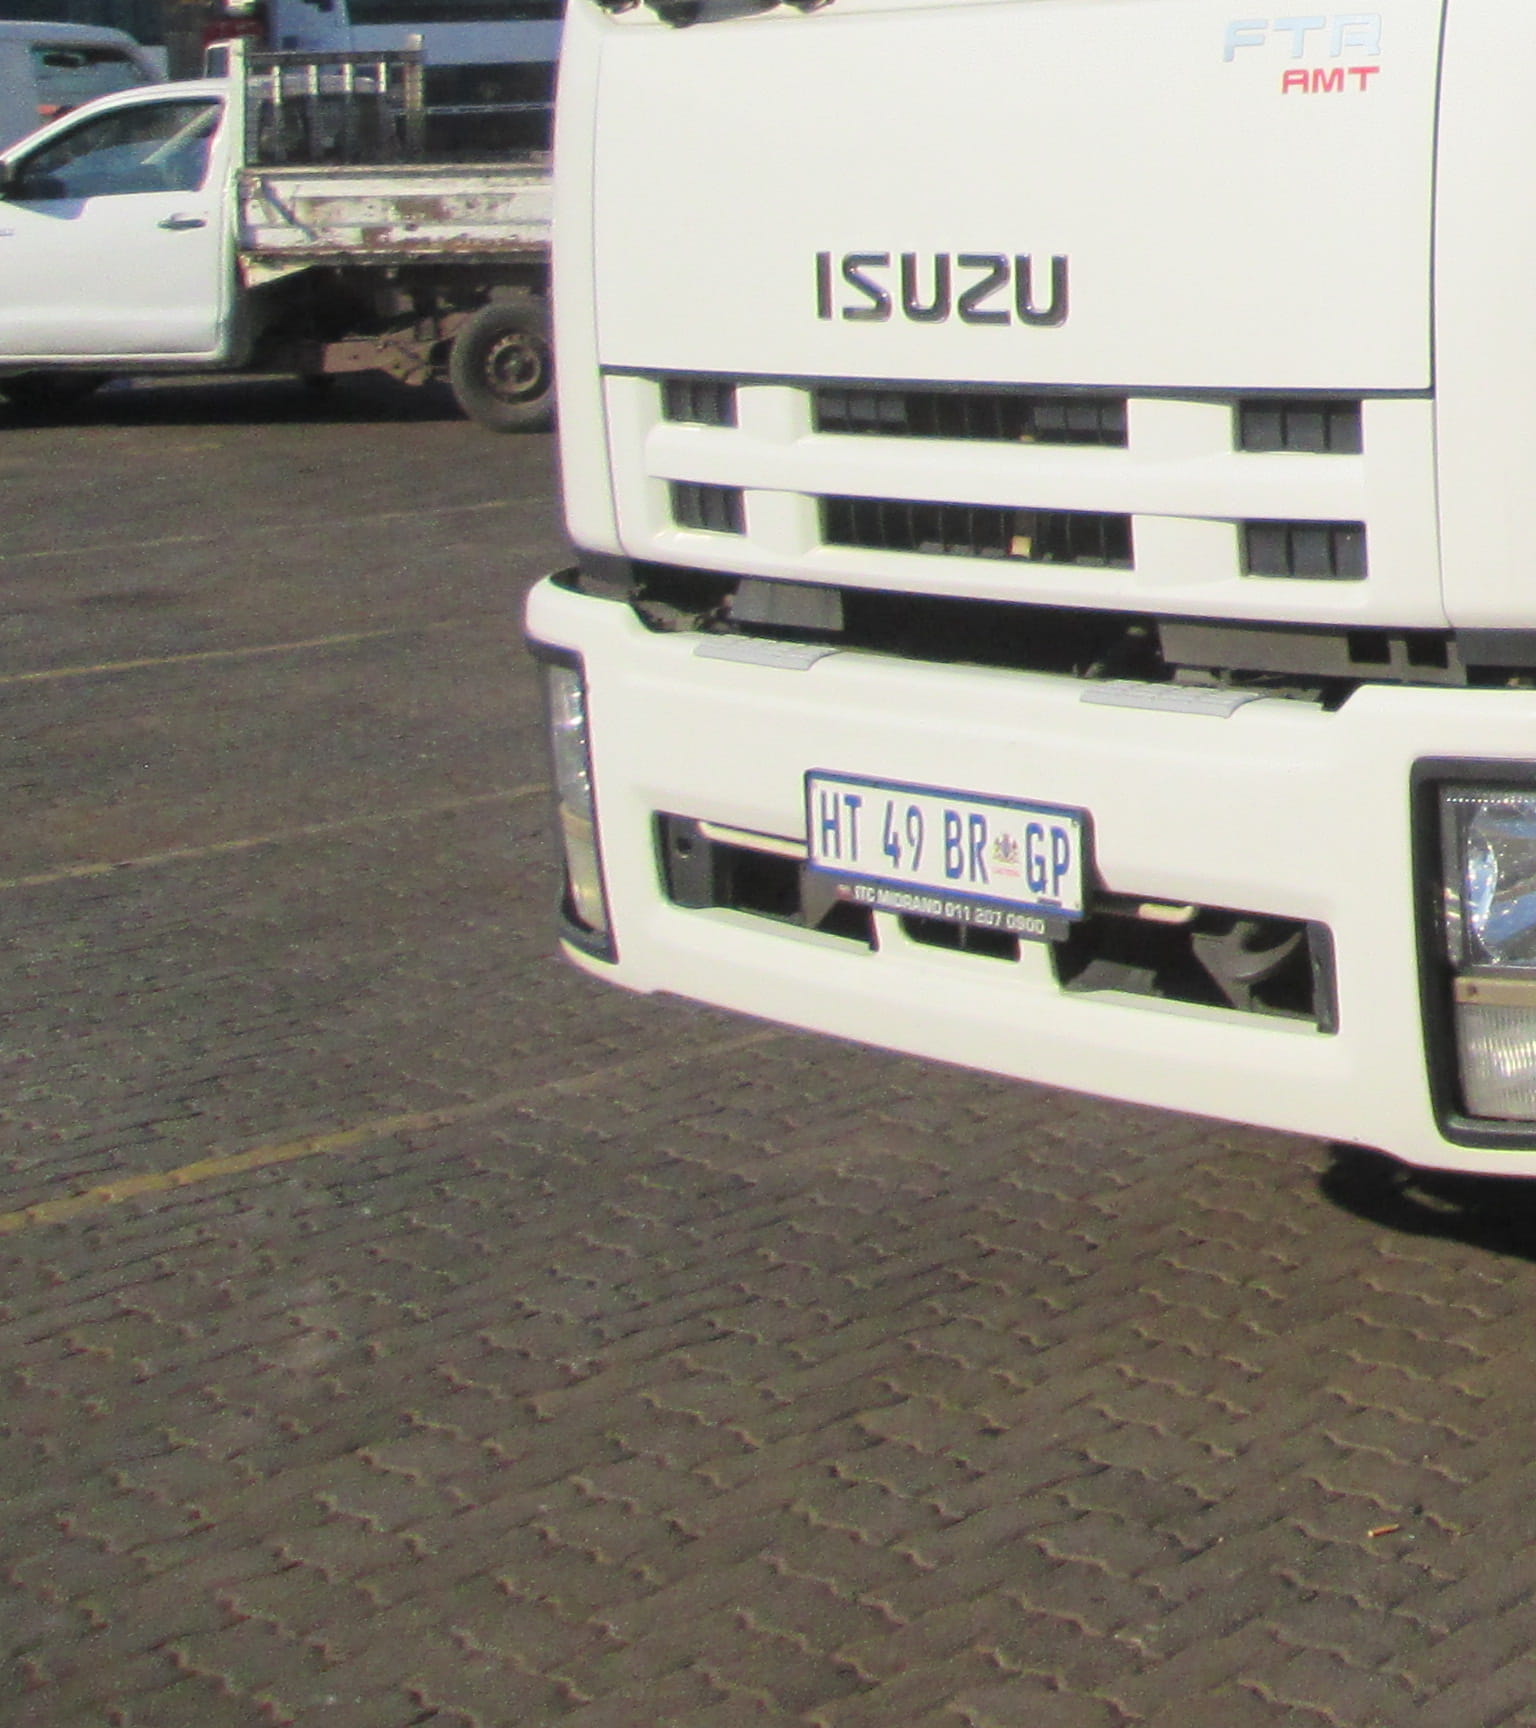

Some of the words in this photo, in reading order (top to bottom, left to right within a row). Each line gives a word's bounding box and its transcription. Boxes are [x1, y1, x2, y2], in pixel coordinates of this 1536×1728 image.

[1223, 14, 1382, 62] FTR
[1282, 66, 1381, 94] AMT
[816, 251, 1068, 327] ISUZU
[820, 789, 863, 862] HT
[883, 800, 925, 872] 49
[943, 809, 990, 885] BR
[1025, 821, 1071, 897] GP
